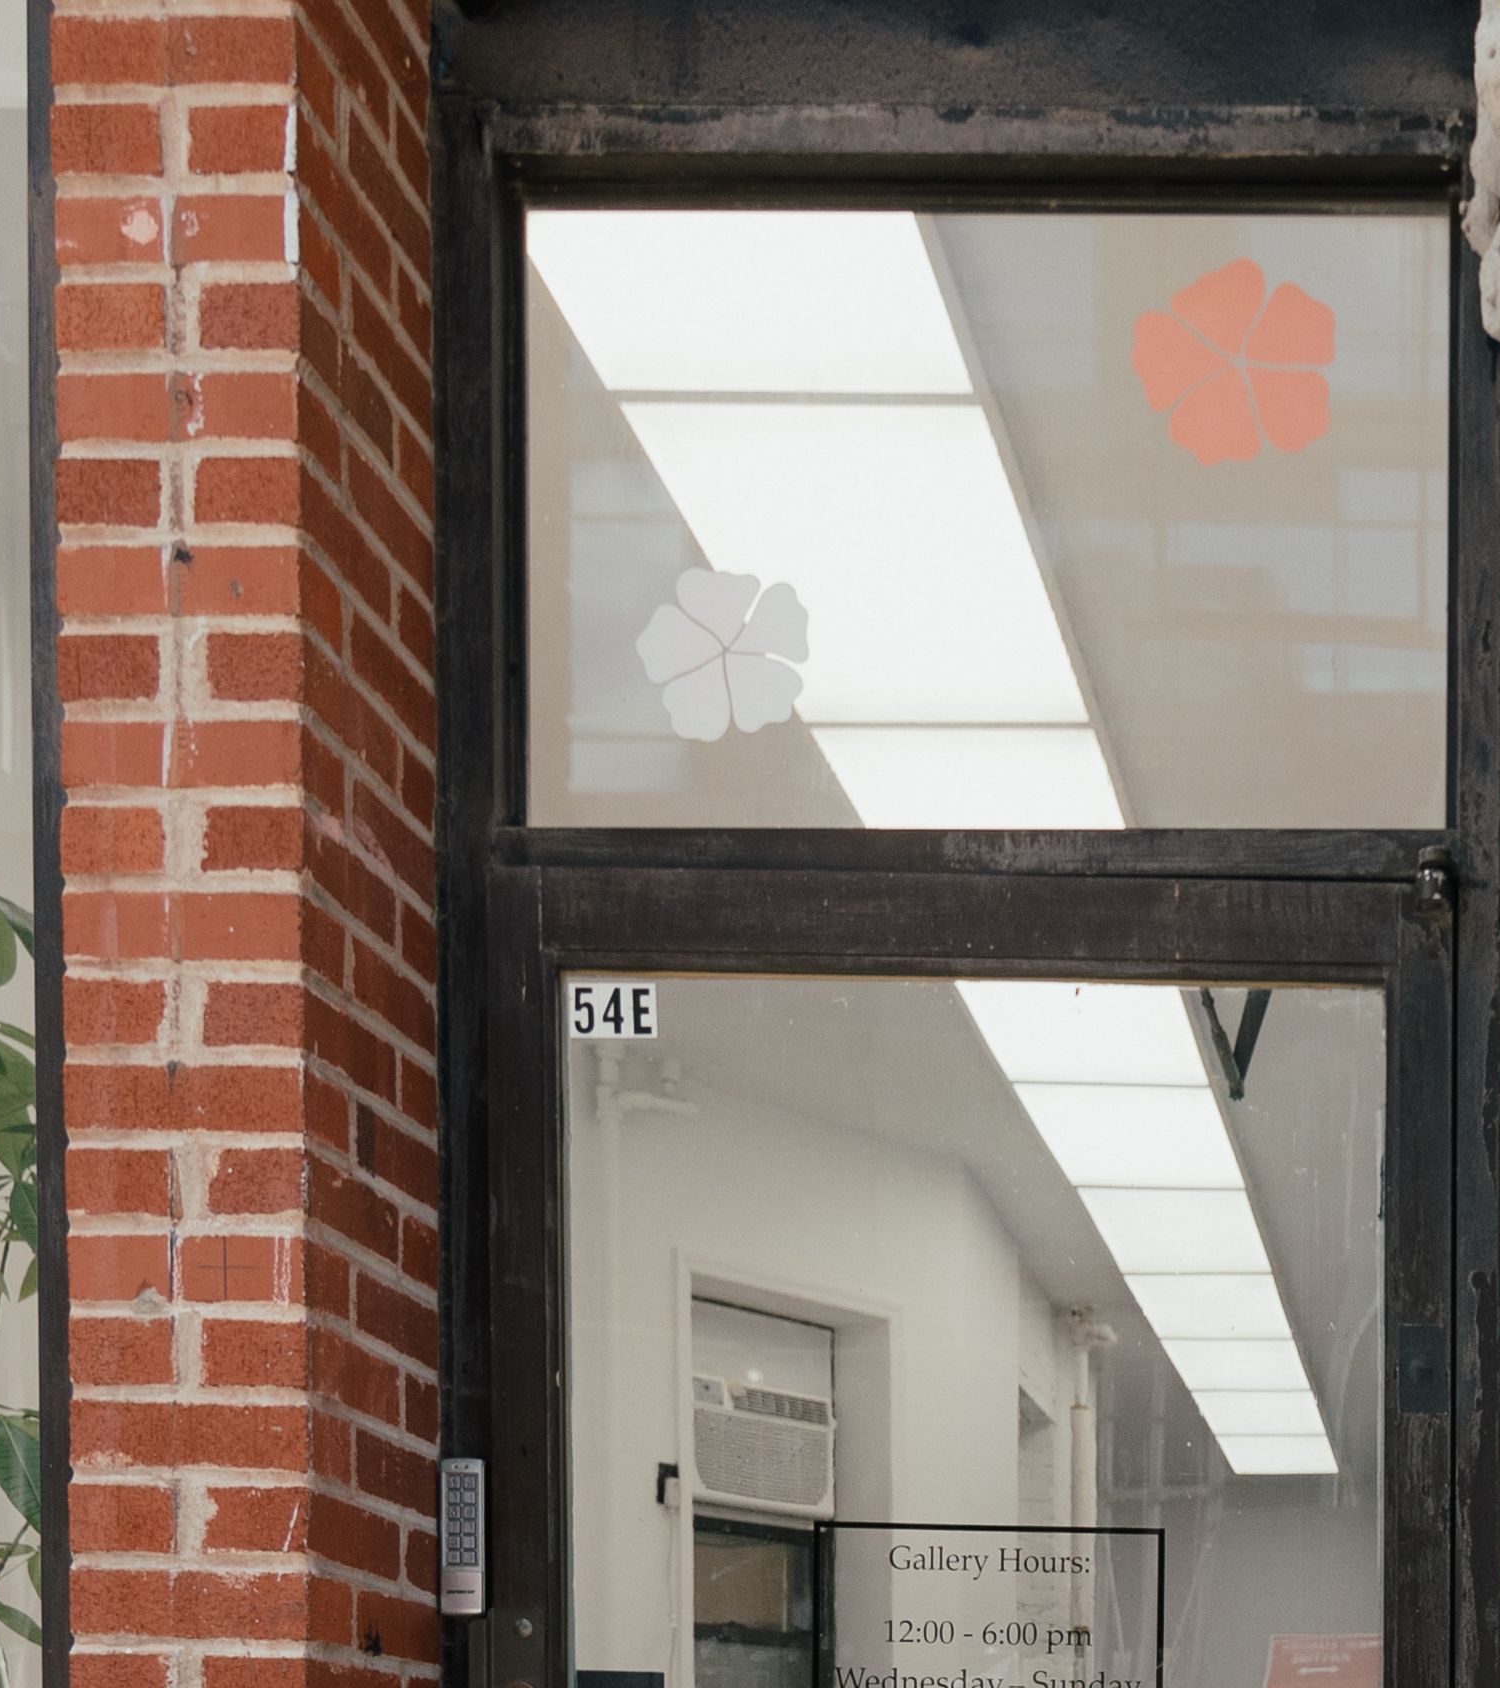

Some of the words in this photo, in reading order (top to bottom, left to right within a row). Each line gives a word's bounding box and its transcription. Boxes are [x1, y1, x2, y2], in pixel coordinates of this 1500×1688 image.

[574, 987, 653, 1035] 54E
[888, 1544, 990, 1581] Gallery
[997, 1547, 1092, 1574] Hours:
[883, 1619, 955, 1645] 12:00
[981, 1621, 1038, 1647] 6:00
[1045, 1627, 1093, 1655] pm
